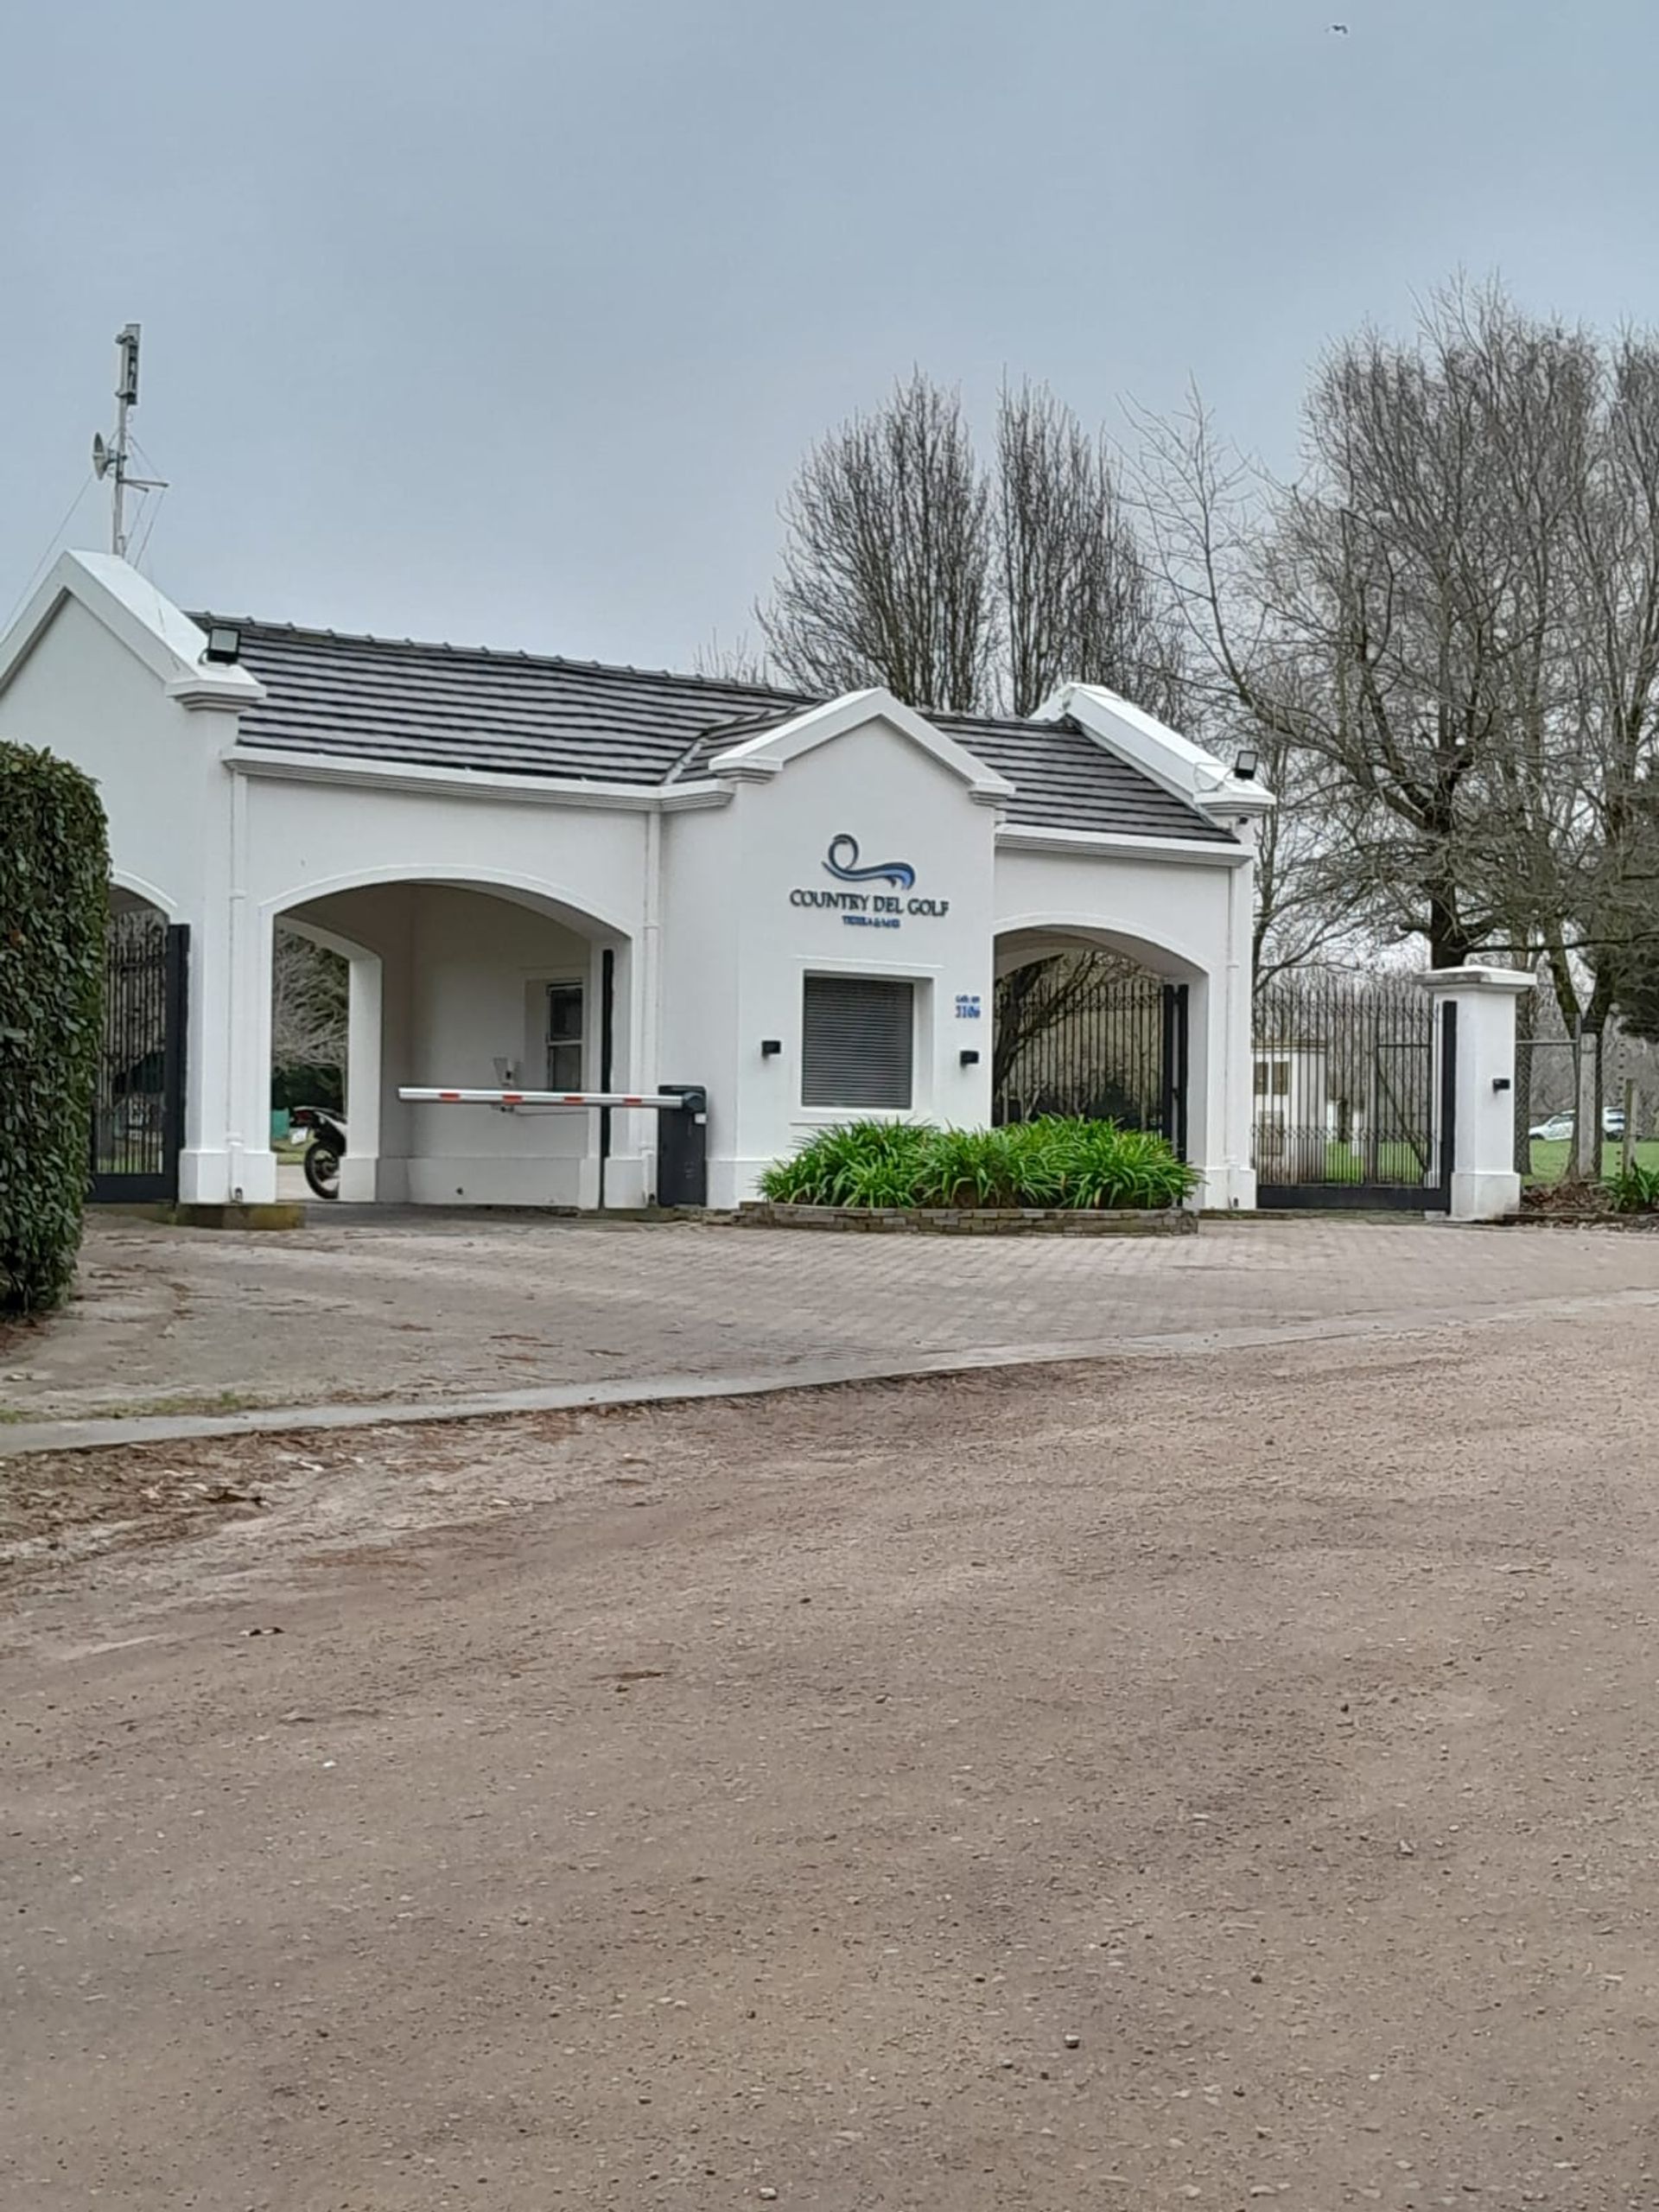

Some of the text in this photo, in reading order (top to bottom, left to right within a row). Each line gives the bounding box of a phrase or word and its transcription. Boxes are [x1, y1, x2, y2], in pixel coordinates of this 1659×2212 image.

[790, 889, 950, 917] COUNTRY DEL GOLF
